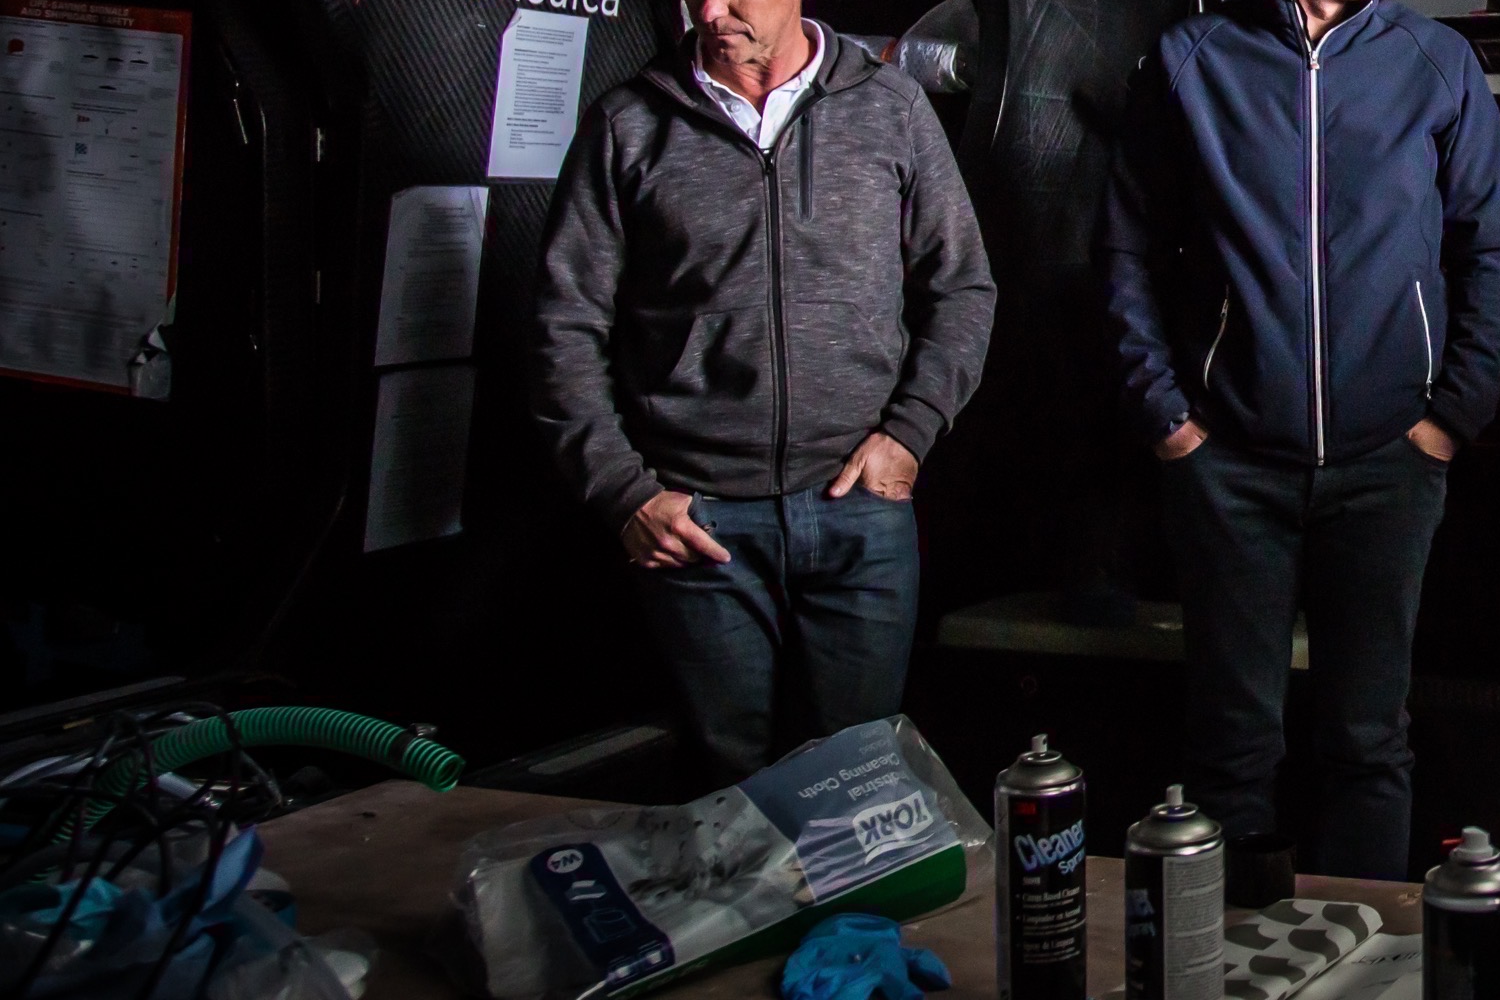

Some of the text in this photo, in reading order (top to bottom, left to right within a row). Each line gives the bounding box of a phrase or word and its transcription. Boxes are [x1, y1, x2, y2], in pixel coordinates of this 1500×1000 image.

[797, 752, 900, 799] Cleaning Cloth
[859, 797, 928, 846] TORK
[1014, 819, 1086, 872] Cleaner
[1057, 847, 1086, 876] Spra
